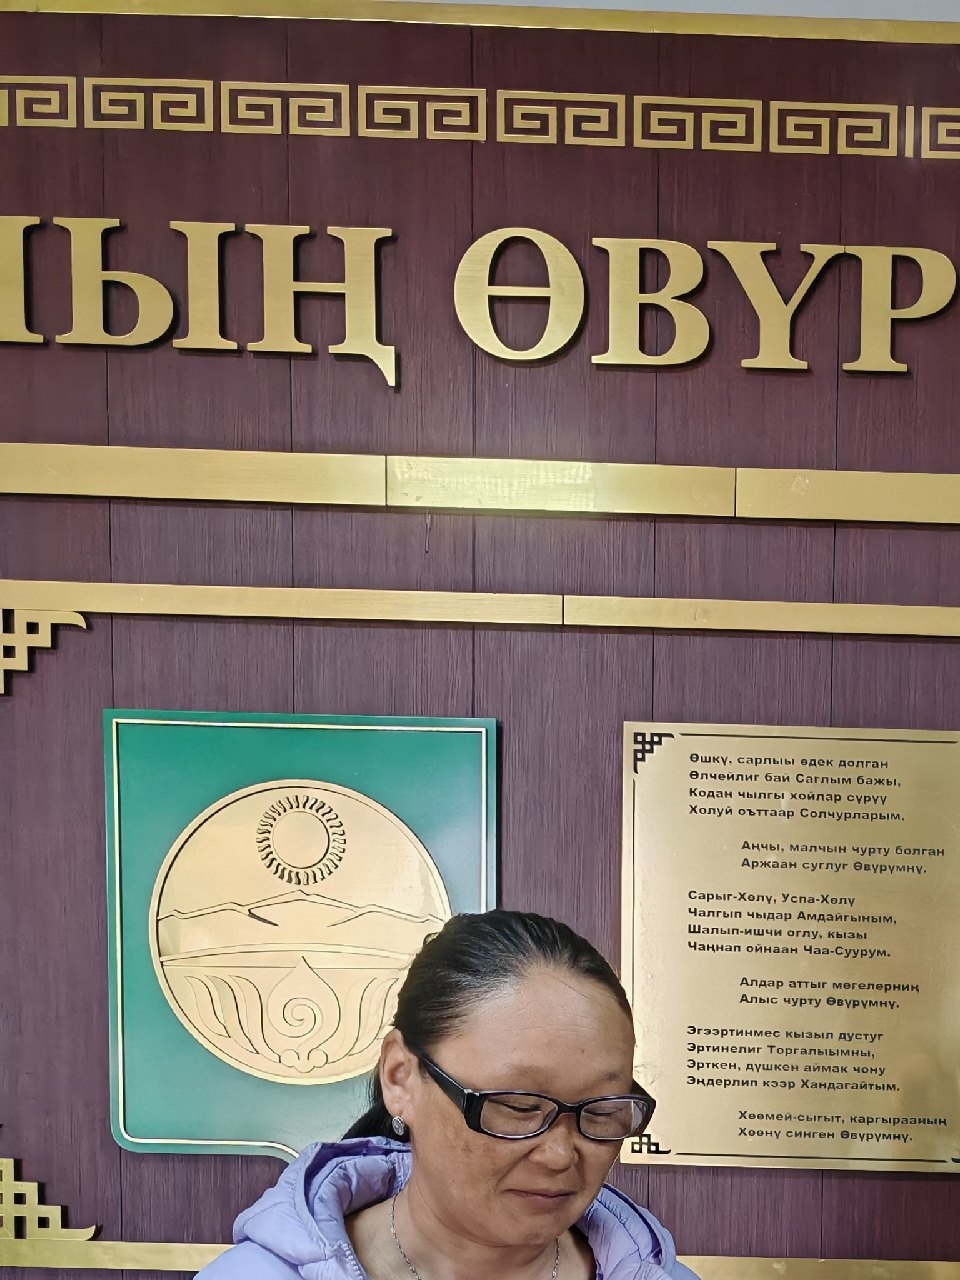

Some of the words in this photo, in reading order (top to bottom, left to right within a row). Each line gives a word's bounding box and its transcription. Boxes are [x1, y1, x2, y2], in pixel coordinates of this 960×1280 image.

[453, 227, 957, 373] ӨВҮР
[838, 758, 889, 770] долган
[764, 771, 790, 783] бай
[795, 773, 852, 785] Саглым
[856, 775, 901, 788] бажы,
[689, 787, 733, 800] Кодан
[738, 790, 785, 802] чылгы
[790, 790, 842, 803] хойлар
[688, 804, 733, 817] Холуй
[799, 807, 905, 821] Солчурларым.
[789, 843, 847, 855] малчын
[852, 846, 890, 857] чурту
[895, 845, 945, 857] болган
[741, 857, 797, 870] Аржаан
[802, 860, 848, 872] суглуг
[688, 908, 742, 919] Чалгып
[746, 910, 792, 922] чыдар
[688, 924, 783, 937] Шалып-ишчи
[827, 930, 868, 941] кызы
[746, 944, 798, 956] ойнаан
[803, 944, 891, 959] Чаа-Суурум.
[739, 977, 784, 989] Алдар
[788, 980, 827, 990] аттыг
[739, 994, 778, 1005] Алыс
[783, 997, 822, 1009] чурту
[785, 1030, 834, 1041] кызыл
[838, 1031, 884, 1043] дустуг
[686, 1043, 762, 1055] Эртинелиг
[686, 1059, 741, 1072] Эрткен,
[803, 1063, 848, 1075] аймак
[853, 1066, 886, 1077] чону
[762, 1080, 796, 1091] кээр
[800, 1079, 900, 1092] Хандагайтым.
